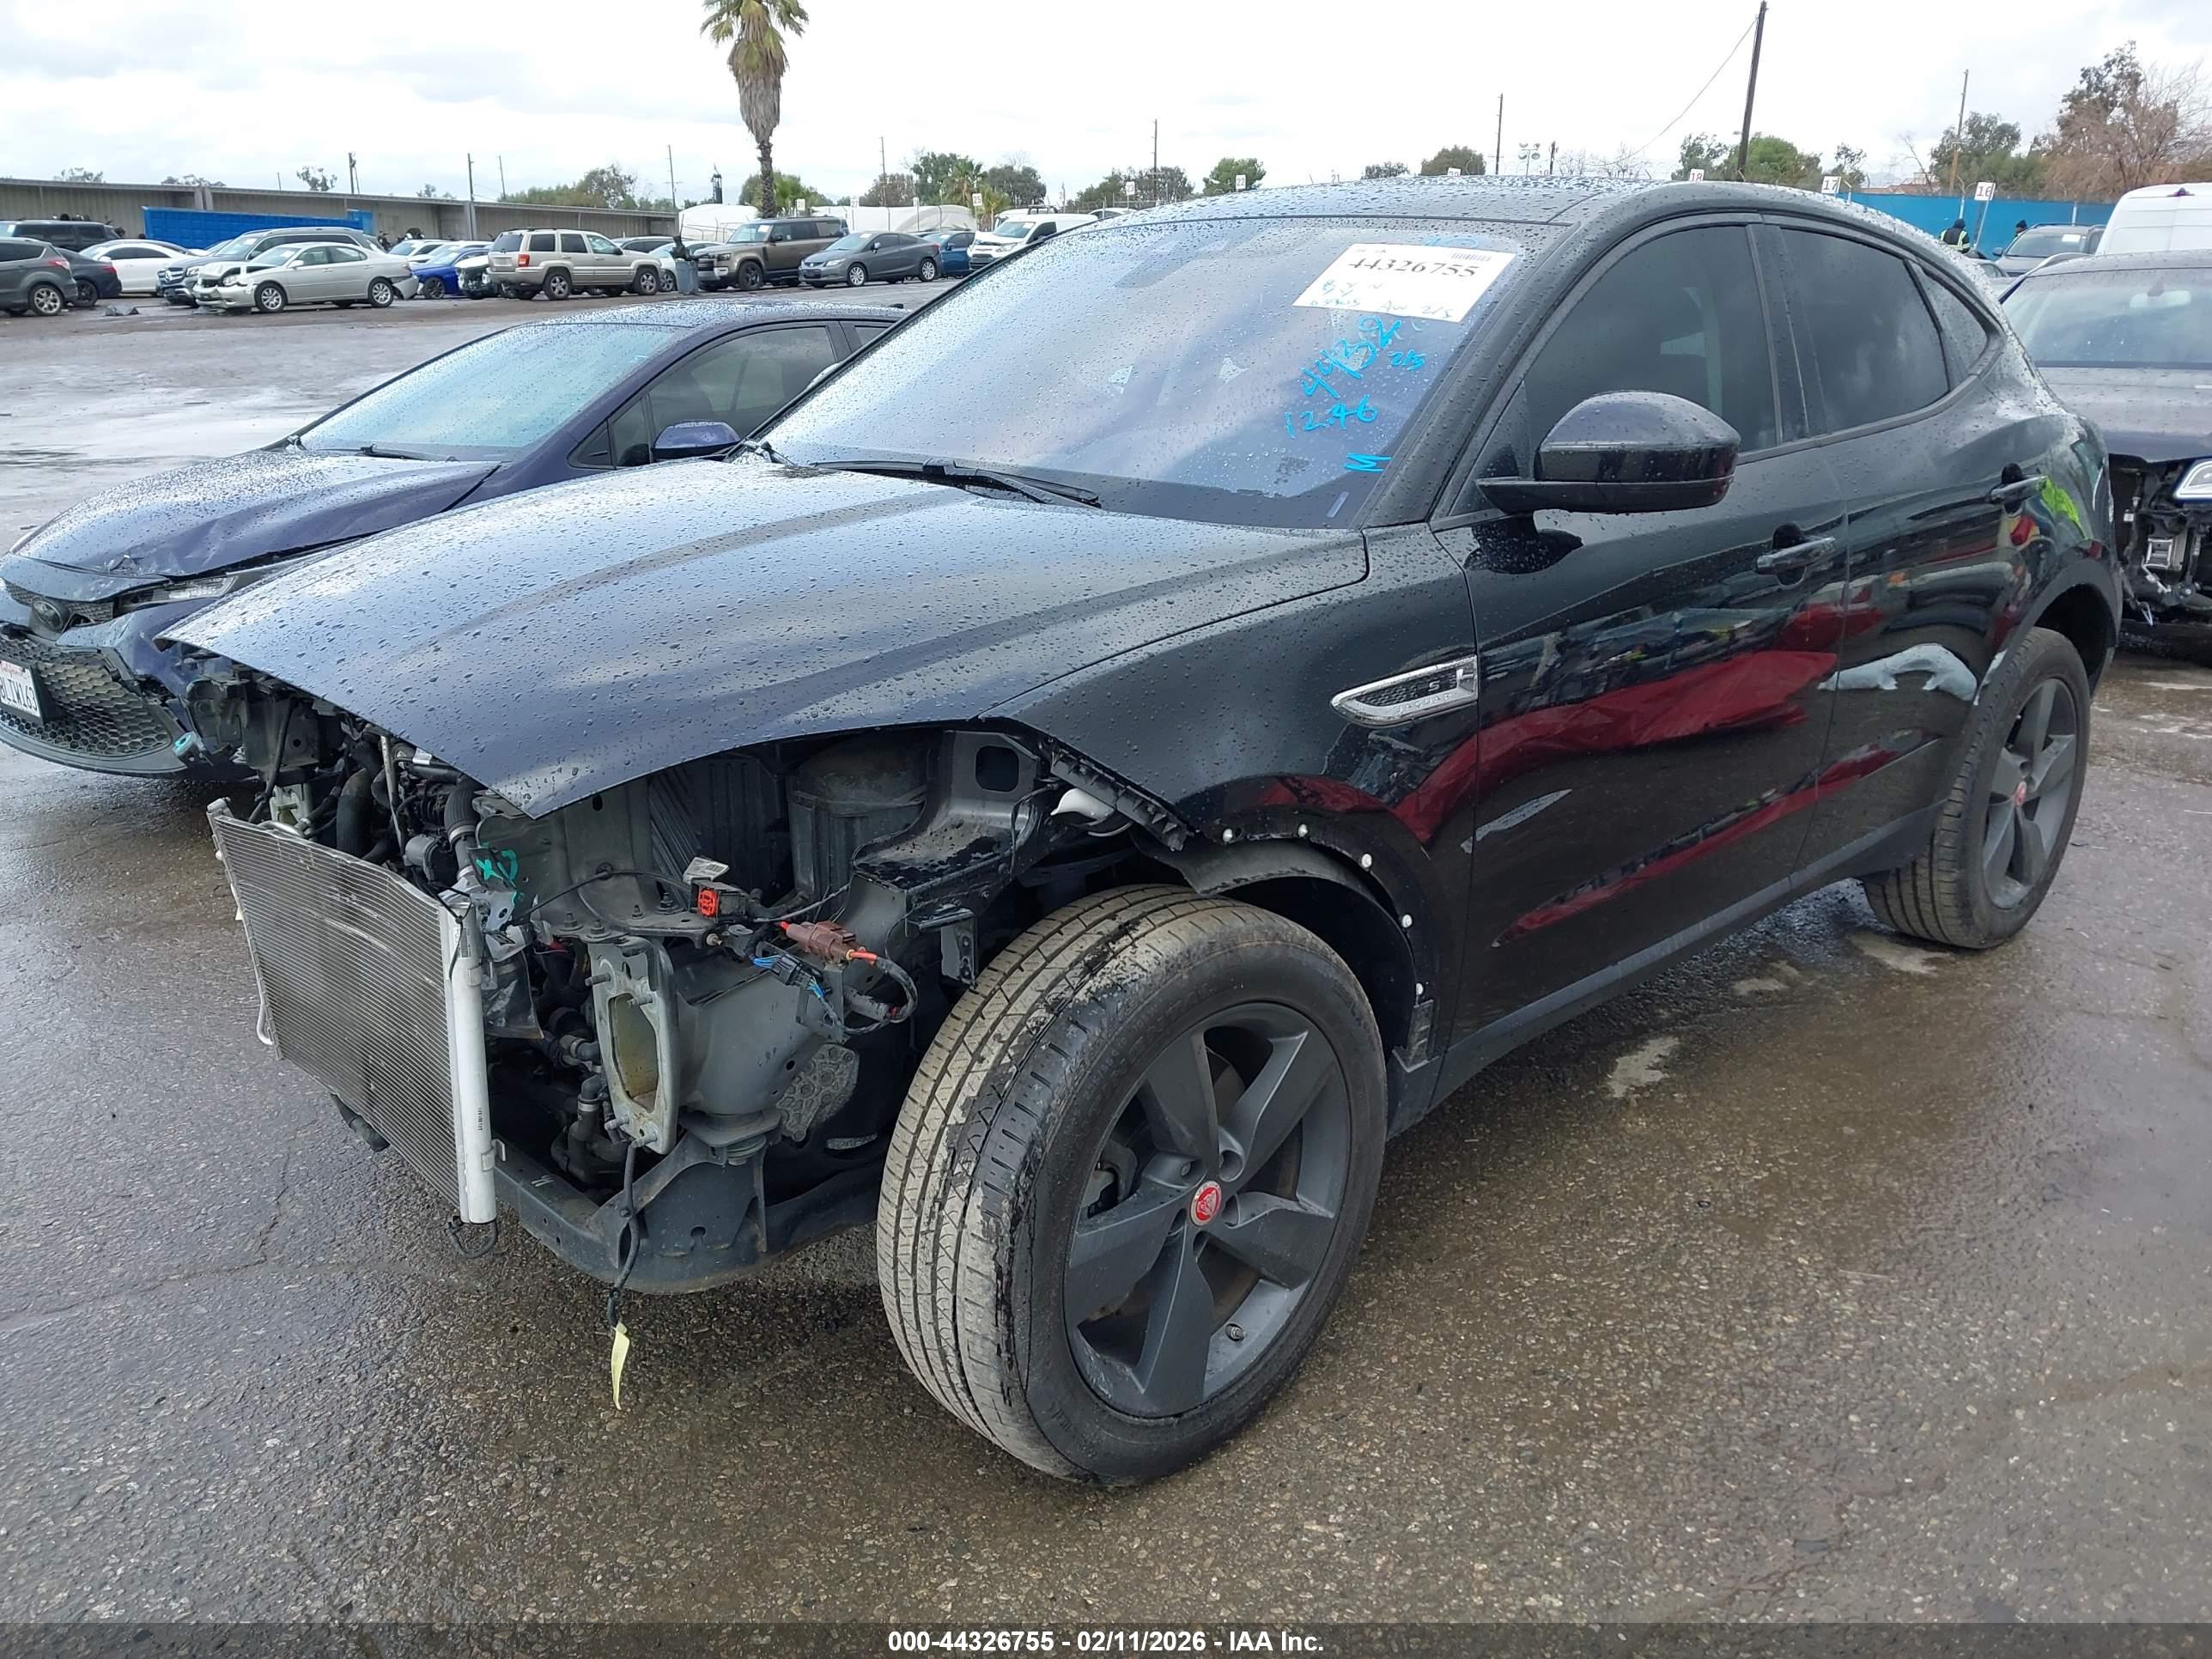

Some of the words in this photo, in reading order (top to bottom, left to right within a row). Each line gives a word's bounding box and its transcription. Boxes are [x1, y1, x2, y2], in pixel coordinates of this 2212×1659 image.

[1237, 178, 1245, 186] 22
[1331, 174, 1340, 184] 21
[1823, 179, 1838, 190] 17
[1977, 185, 1993, 197] 16
[974, 195, 981, 204] 25
[1348, 258, 1480, 277] 44326755
[1427, 680, 1441, 692] S
[1395, 692, 1453, 714] JAGUAR
